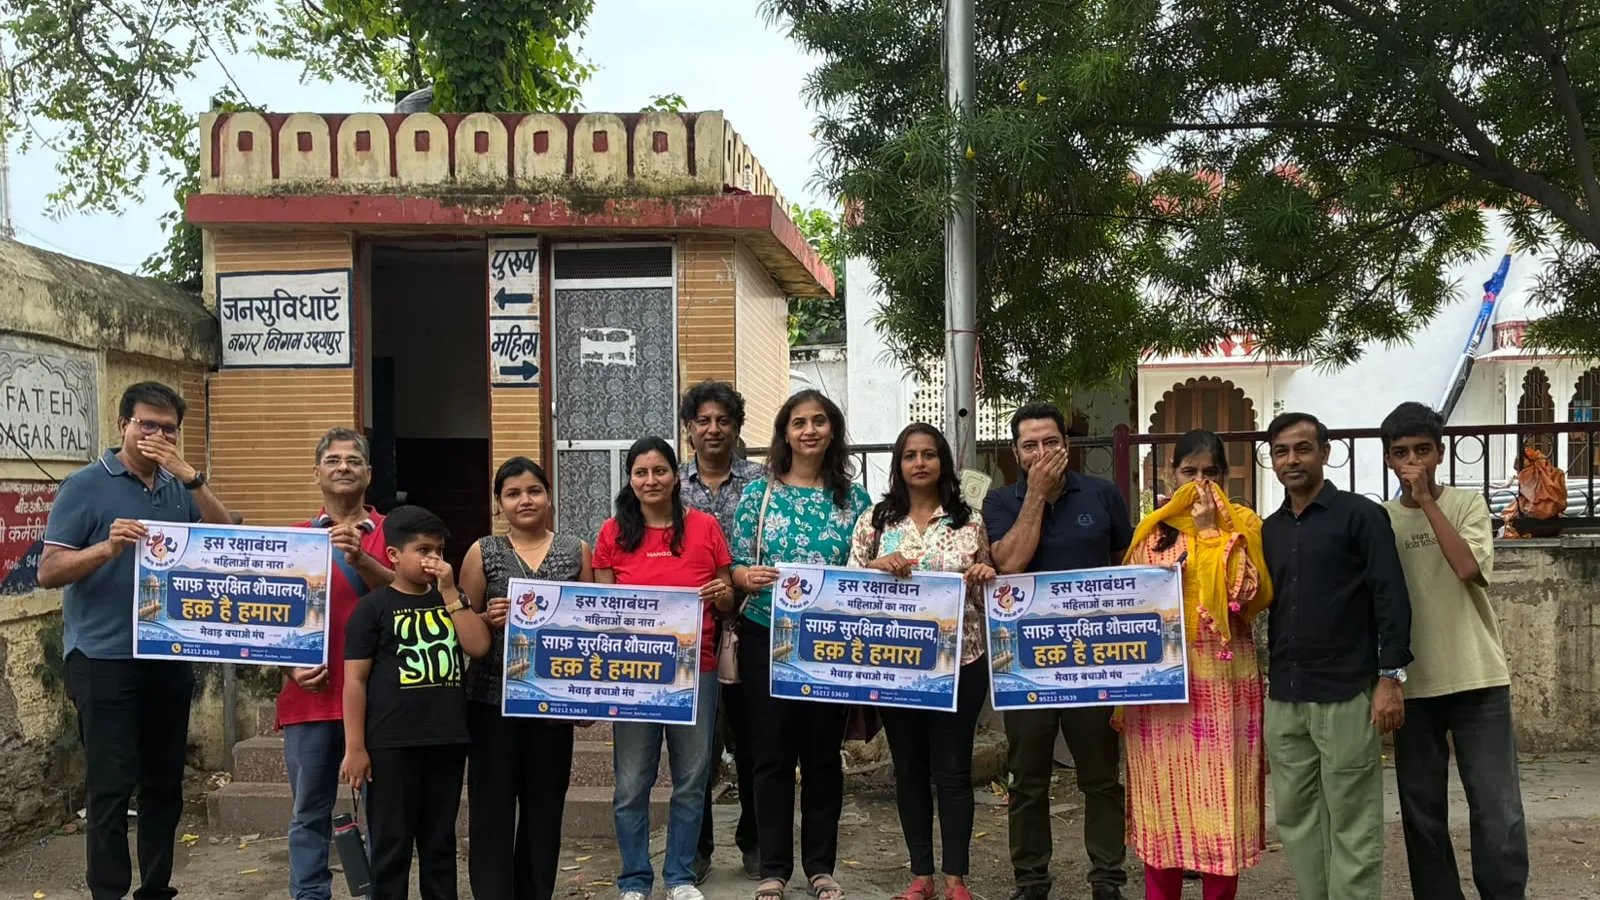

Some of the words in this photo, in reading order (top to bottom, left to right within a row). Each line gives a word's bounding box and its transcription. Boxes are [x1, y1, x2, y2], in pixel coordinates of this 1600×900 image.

[227, 333, 264, 356] नगर
[263, 327, 304, 352] निगम
[304, 331, 346, 356] उदयपुर
[491, 325, 539, 362] महिला
[6, 385, 73, 417] FATEH
[61, 425, 87, 451] PAL
[204, 536, 224, 550] इस
[229, 535, 287, 552] रक्षाबंधन
[251, 560, 264, 568] का
[266, 561, 284, 569] नारा
[172, 577, 203, 592] साफ़
[206, 575, 251, 598] सुरक्षित
[252, 577, 306, 600] शौचालय,
[838, 579, 858, 593] इस
[862, 579, 920, 596] रक्षाबंधन
[1050, 581, 1072, 595] इस
[1076, 575, 1136, 593] रक्षाबंधन
[181, 598, 214, 620] हक़
[218, 595, 232, 622] है
[238, 602, 292, 622] हमारा
[575, 594, 597, 608] इस
[601, 594, 659, 610] रक्षाबंधन
[884, 602, 896, 611] का
[898, 603, 916, 612] नारा
[1102, 600, 1114, 608] का
[1117, 598, 1135, 607] नारा
[225, 628, 250, 638] बचाओ
[252, 628, 264, 639] मंच
[624, 618, 635, 626] का
[638, 618, 655, 627] नारा
[806, 619, 836, 634] साफ़
[840, 618, 884, 640] सुरक्षित
[885, 620, 937, 643] शौचालय,
[1022, 625, 1054, 640] साफ़
[1058, 618, 1103, 642] सुरक्षित
[1106, 616, 1160, 636] शौचालय,
[542, 635, 574, 650] साफ़
[577, 634, 622, 656] सुरक्षित
[624, 636, 676, 658] शौचालय,
[813, 640, 846, 661] हक़
[852, 636, 864, 663] है
[870, 644, 922, 665] हमारा
[1032, 645, 1067, 667] हक़
[1072, 638, 1086, 664] है
[1092, 641, 1147, 663] हमारा
[550, 657, 584, 677] हक़
[589, 652, 603, 679] है
[608, 660, 662, 680] हमारा
[855, 670, 881, 681] बचाओ
[883, 671, 895, 682] मंच
[1081, 670, 1107, 680] बचाओ
[1110, 670, 1122, 680] मंच
[594, 685, 620, 696] बचाओ
[622, 686, 635, 697] मंच
